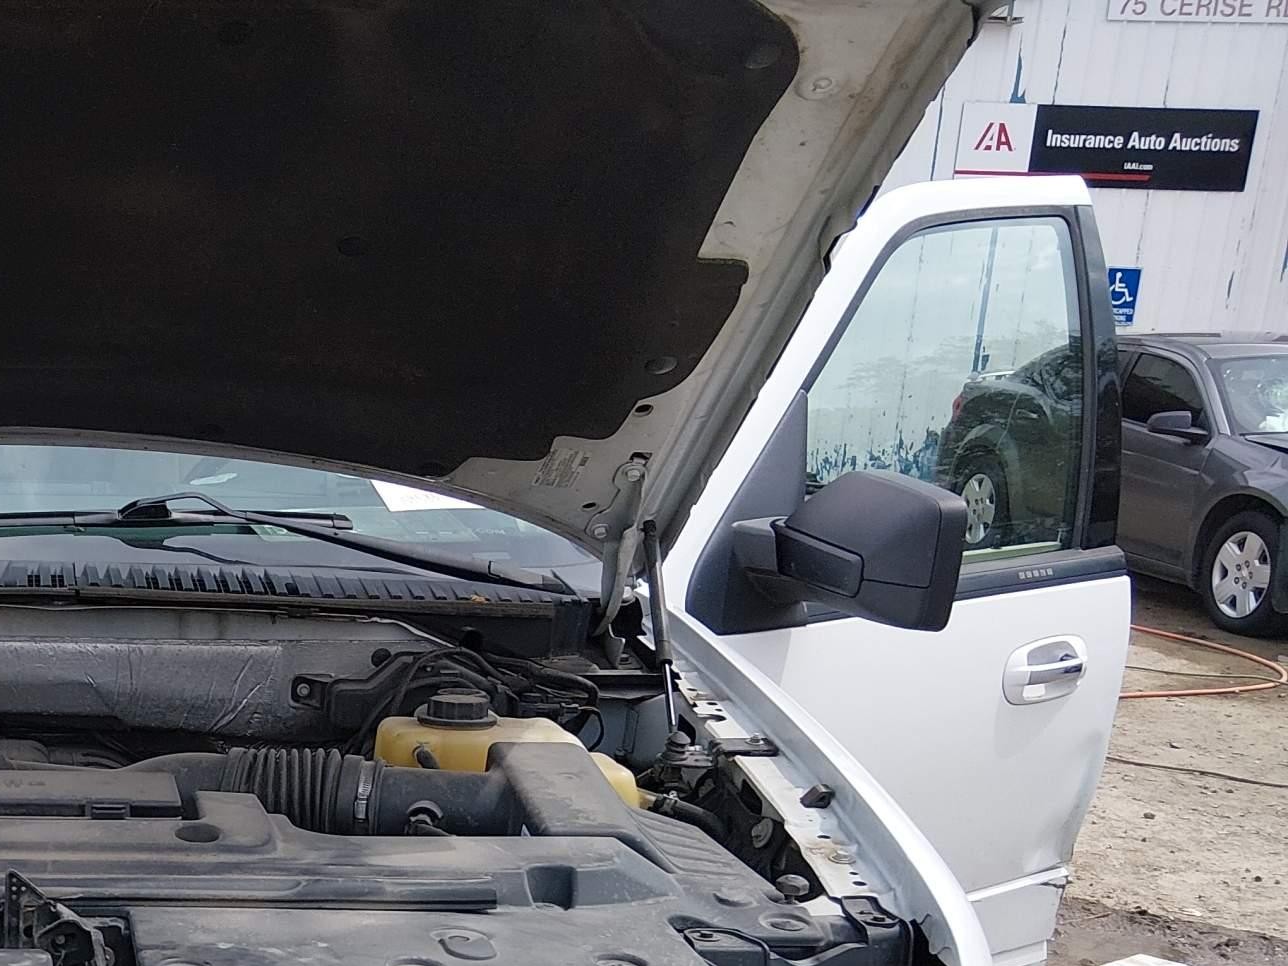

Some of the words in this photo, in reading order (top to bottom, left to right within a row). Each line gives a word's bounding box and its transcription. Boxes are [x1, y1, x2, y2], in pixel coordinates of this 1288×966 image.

[1120, 0, 1147, 16] 75
[1160, 0, 1253, 17] CERISE
[1265, 0, 1288, 18] R
[1046, 129, 1123, 149] Insurance
[1127, 131, 1165, 151] Auto
[1168, 132, 1240, 152] Auctions
